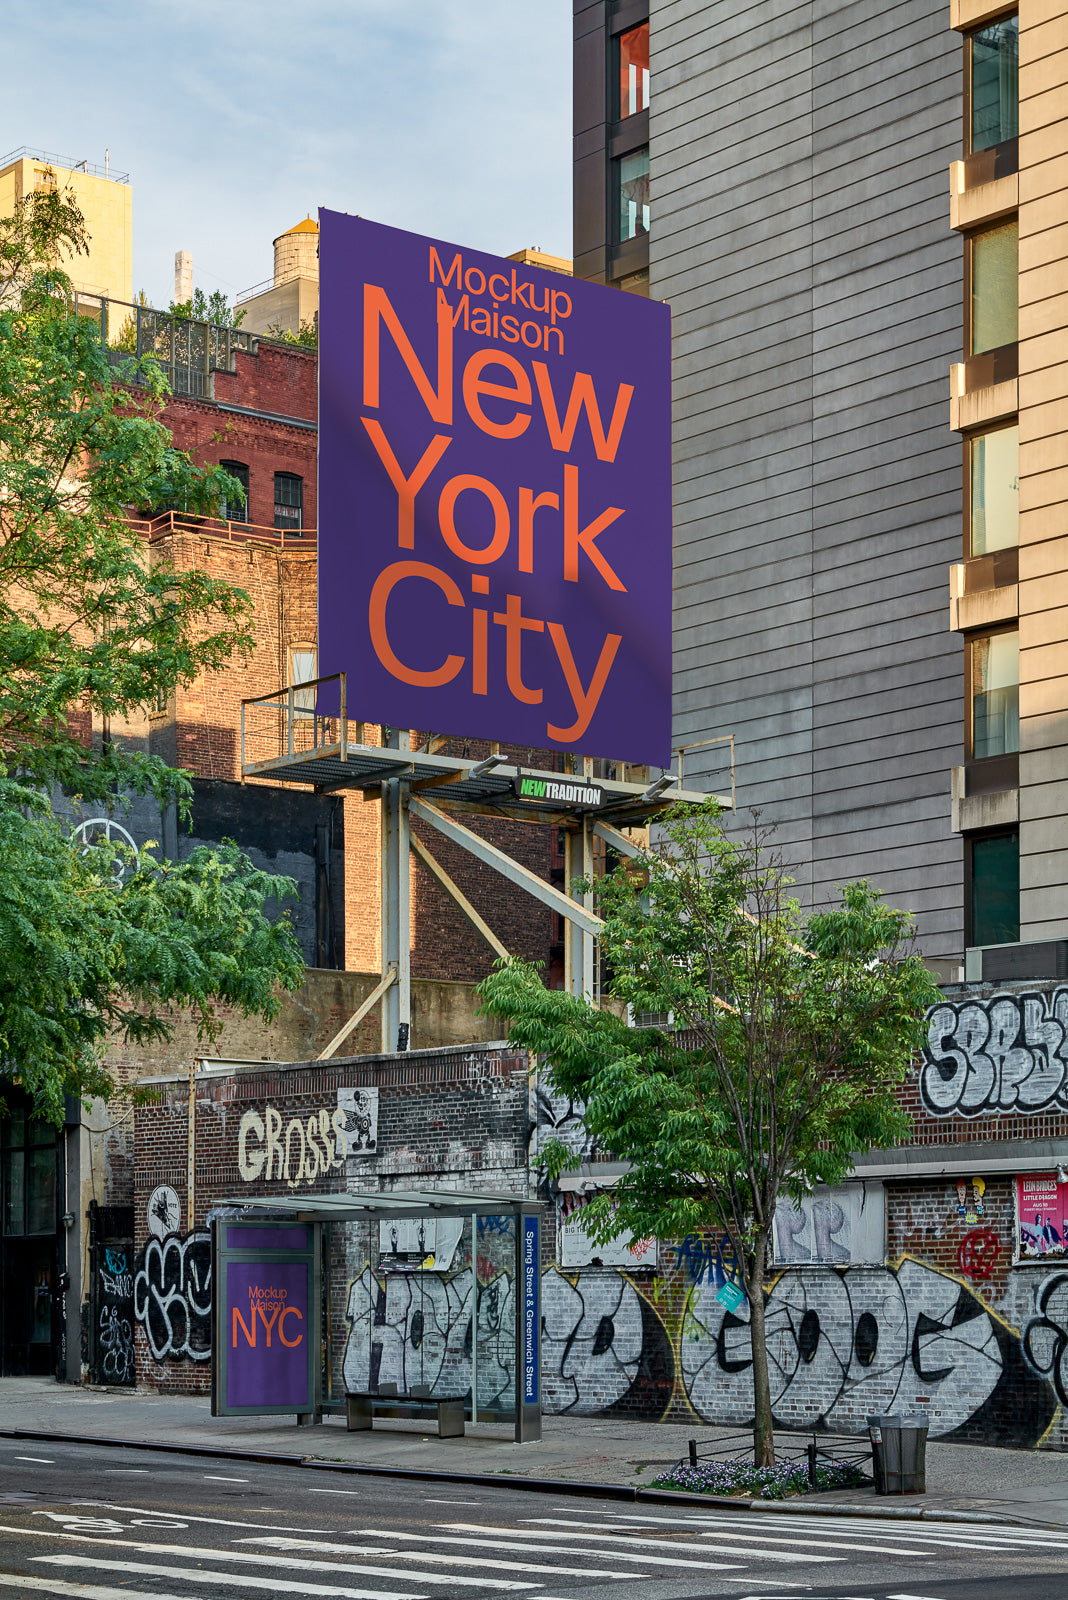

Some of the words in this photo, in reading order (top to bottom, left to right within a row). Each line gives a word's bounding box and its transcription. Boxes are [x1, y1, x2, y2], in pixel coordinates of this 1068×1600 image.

[429, 246, 573, 325] Mockup
[437, 287, 564, 355] Maison
[362, 283, 635, 463] New
[360, 416, 628, 593] York
[368, 560, 623, 743] City
[1023, 1181, 1036, 1192] LEON
[1036, 1180, 1057, 1191] BRIDGES
[525, 1231, 534, 1264] Spring
[564, 1226, 575, 1234] BIG
[248, 1285, 287, 1301] Mockup
[526, 1266, 534, 1297] Street
[250, 1298, 285, 1312] Maison
[232, 1306, 303, 1348] NYC
[526, 1309, 534, 1364] Greenwich
[526, 1366, 534, 1397] Street
